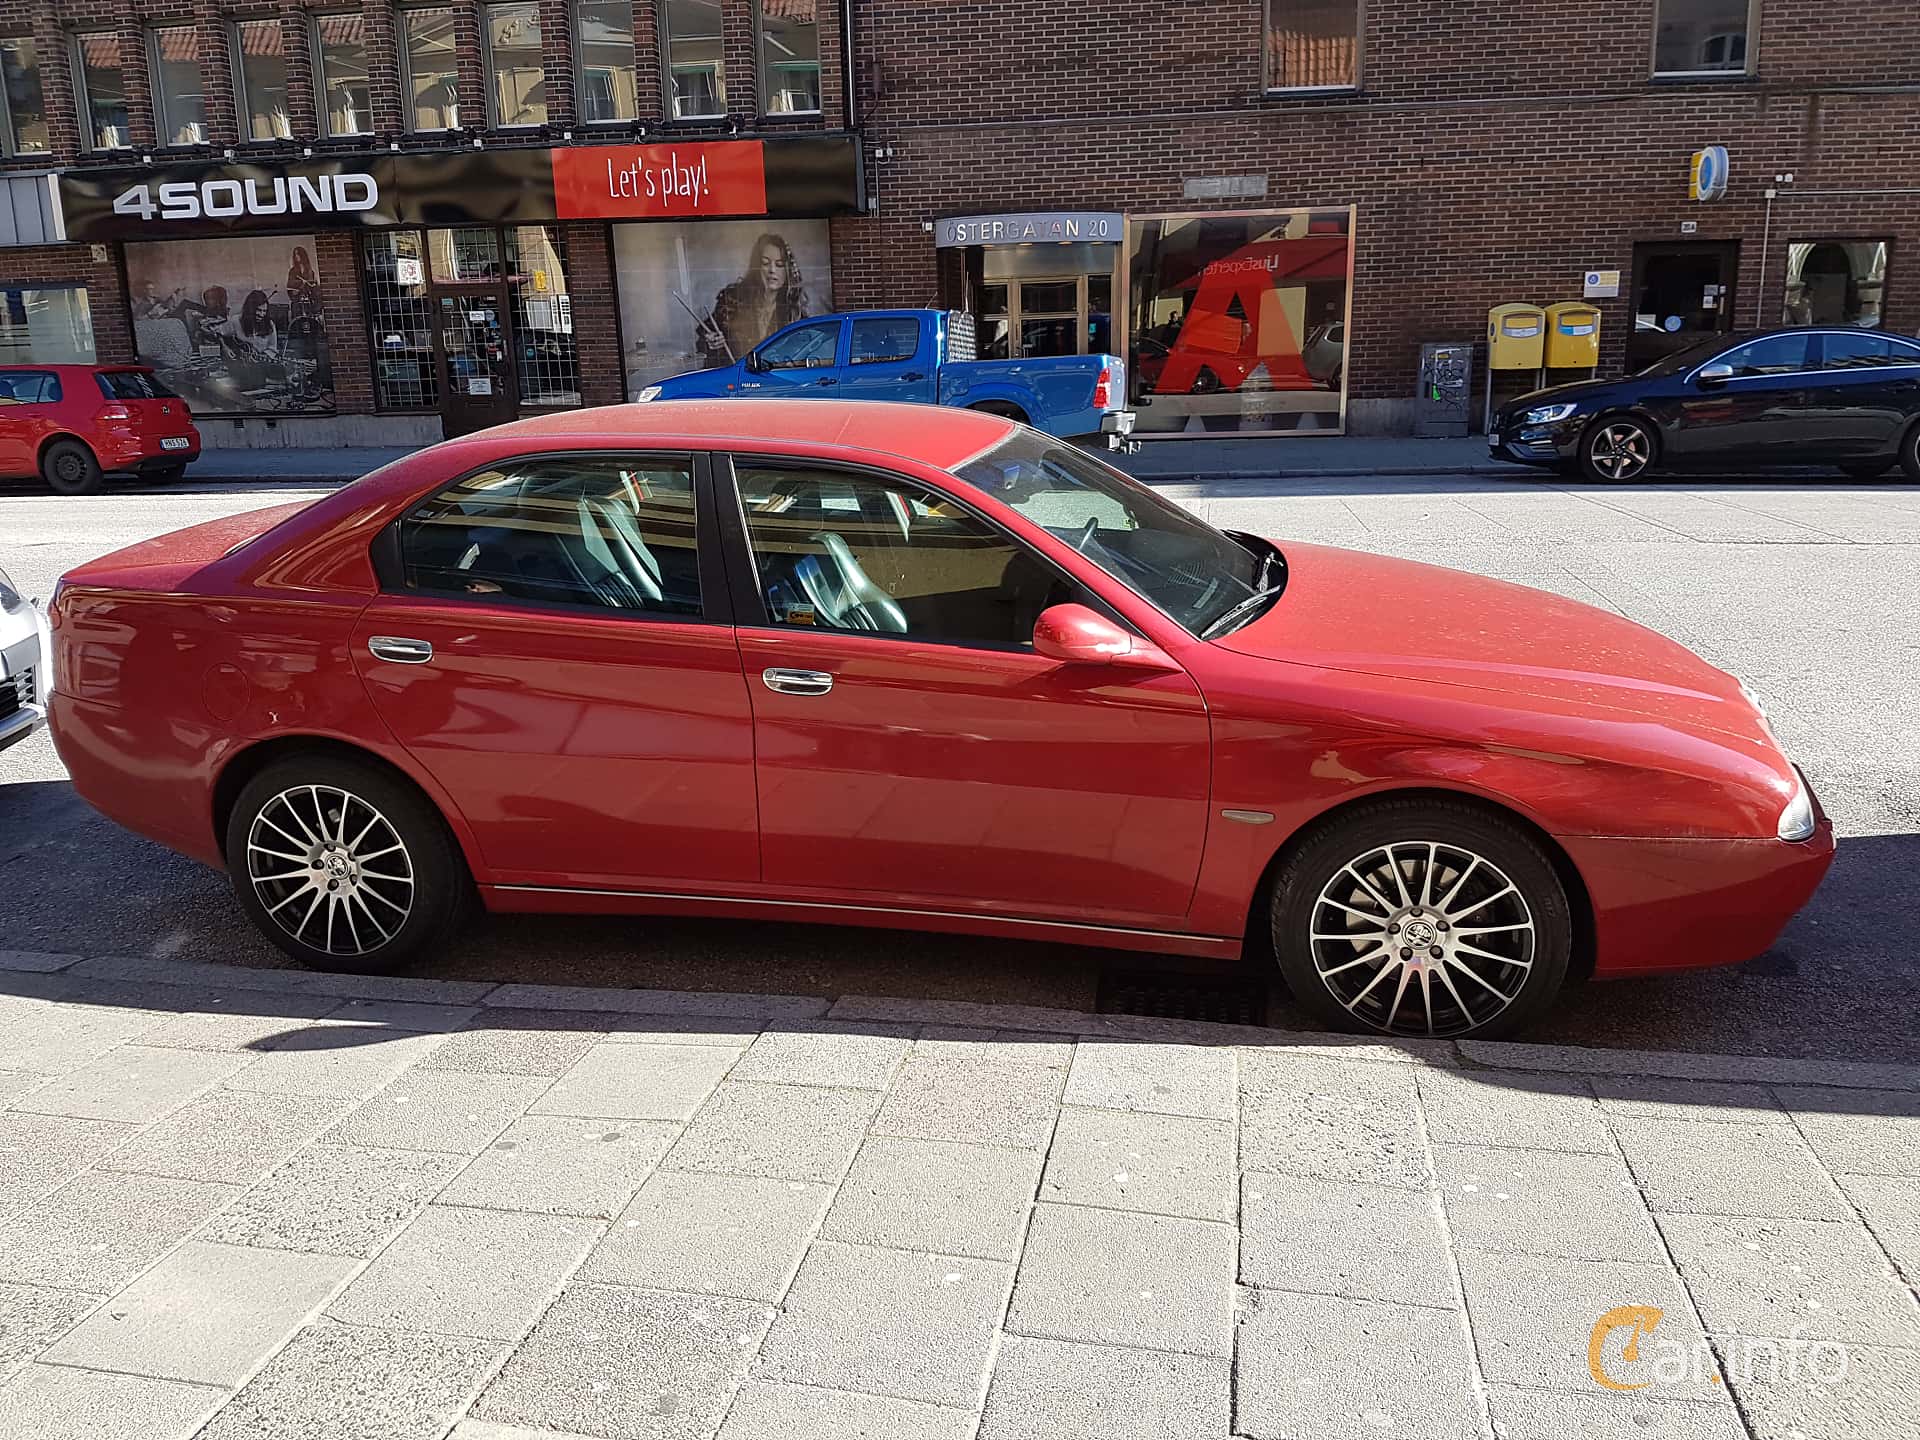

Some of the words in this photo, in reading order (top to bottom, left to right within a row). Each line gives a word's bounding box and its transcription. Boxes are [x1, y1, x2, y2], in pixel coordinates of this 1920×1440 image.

[112, 173, 379, 221] 4SOUND
[607, 156, 655, 198] Let's
[661, 151, 709, 208] play!
[946, 218, 1079, 242] ÖSTERGATAN
[1088, 219, 1108, 237] 20
